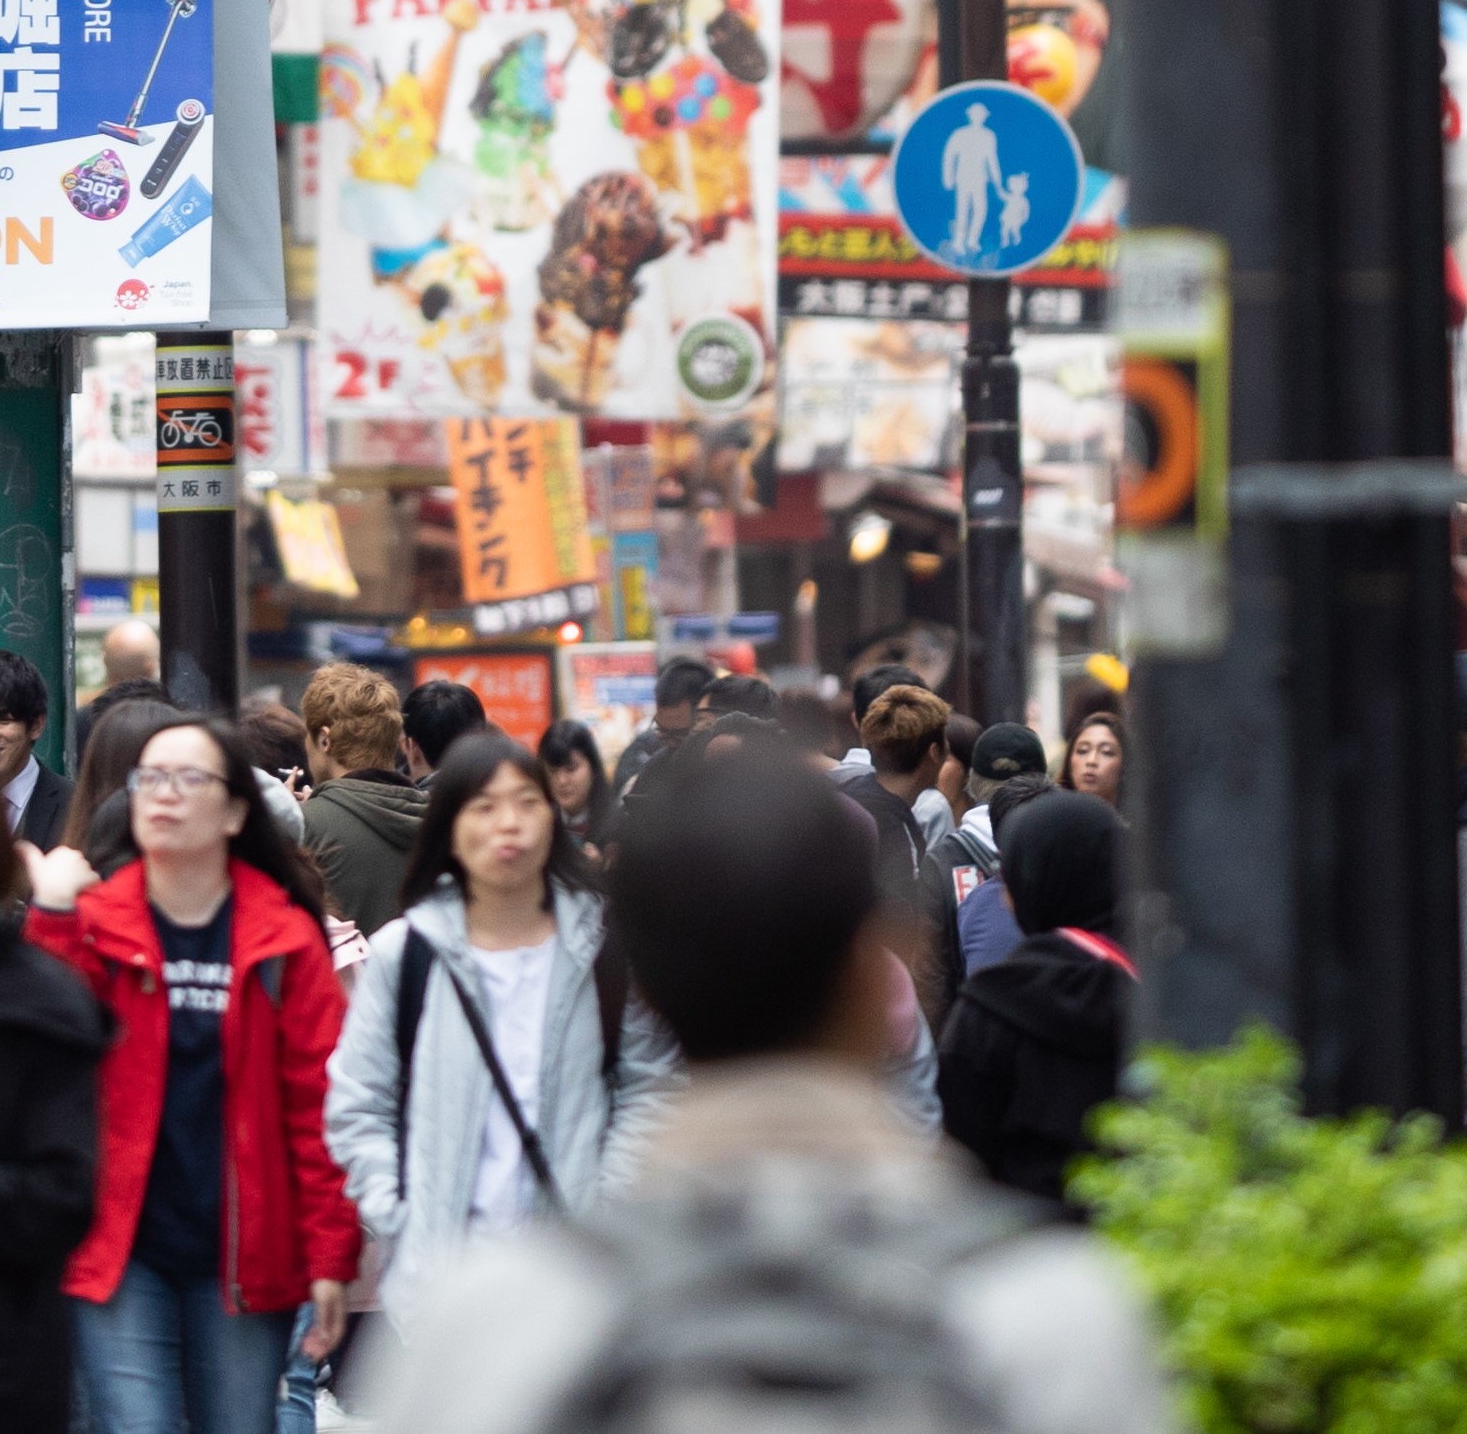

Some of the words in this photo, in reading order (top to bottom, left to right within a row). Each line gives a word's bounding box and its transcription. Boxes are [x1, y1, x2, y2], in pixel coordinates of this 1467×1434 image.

[332, 350, 400, 400] 2F
[163, 480, 223, 498] 大阪市
